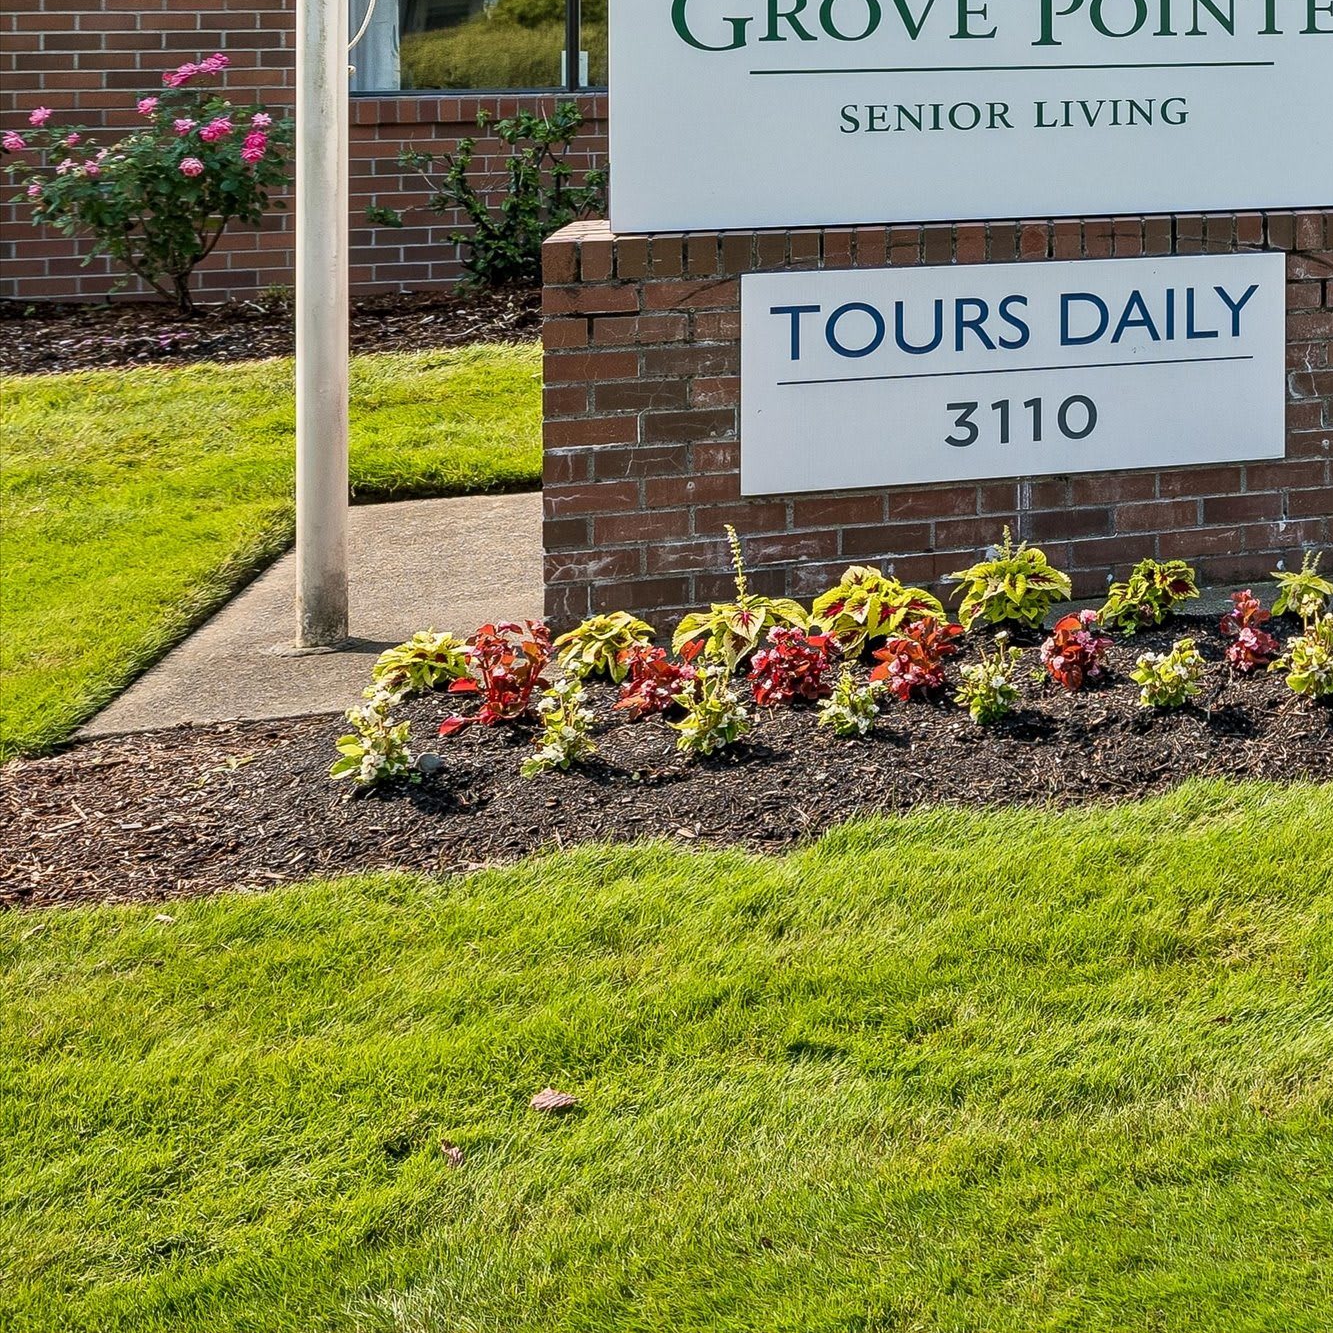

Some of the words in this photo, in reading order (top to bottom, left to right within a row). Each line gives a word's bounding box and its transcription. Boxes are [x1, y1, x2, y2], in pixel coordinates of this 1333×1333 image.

[839, 102, 1015, 134] SENIOR
[1033, 97, 1190, 129] LIVING
[769, 294, 1030, 361] TOURS
[1059, 284, 1260, 347] DAILY
[944, 394, 1098, 448] 3110
